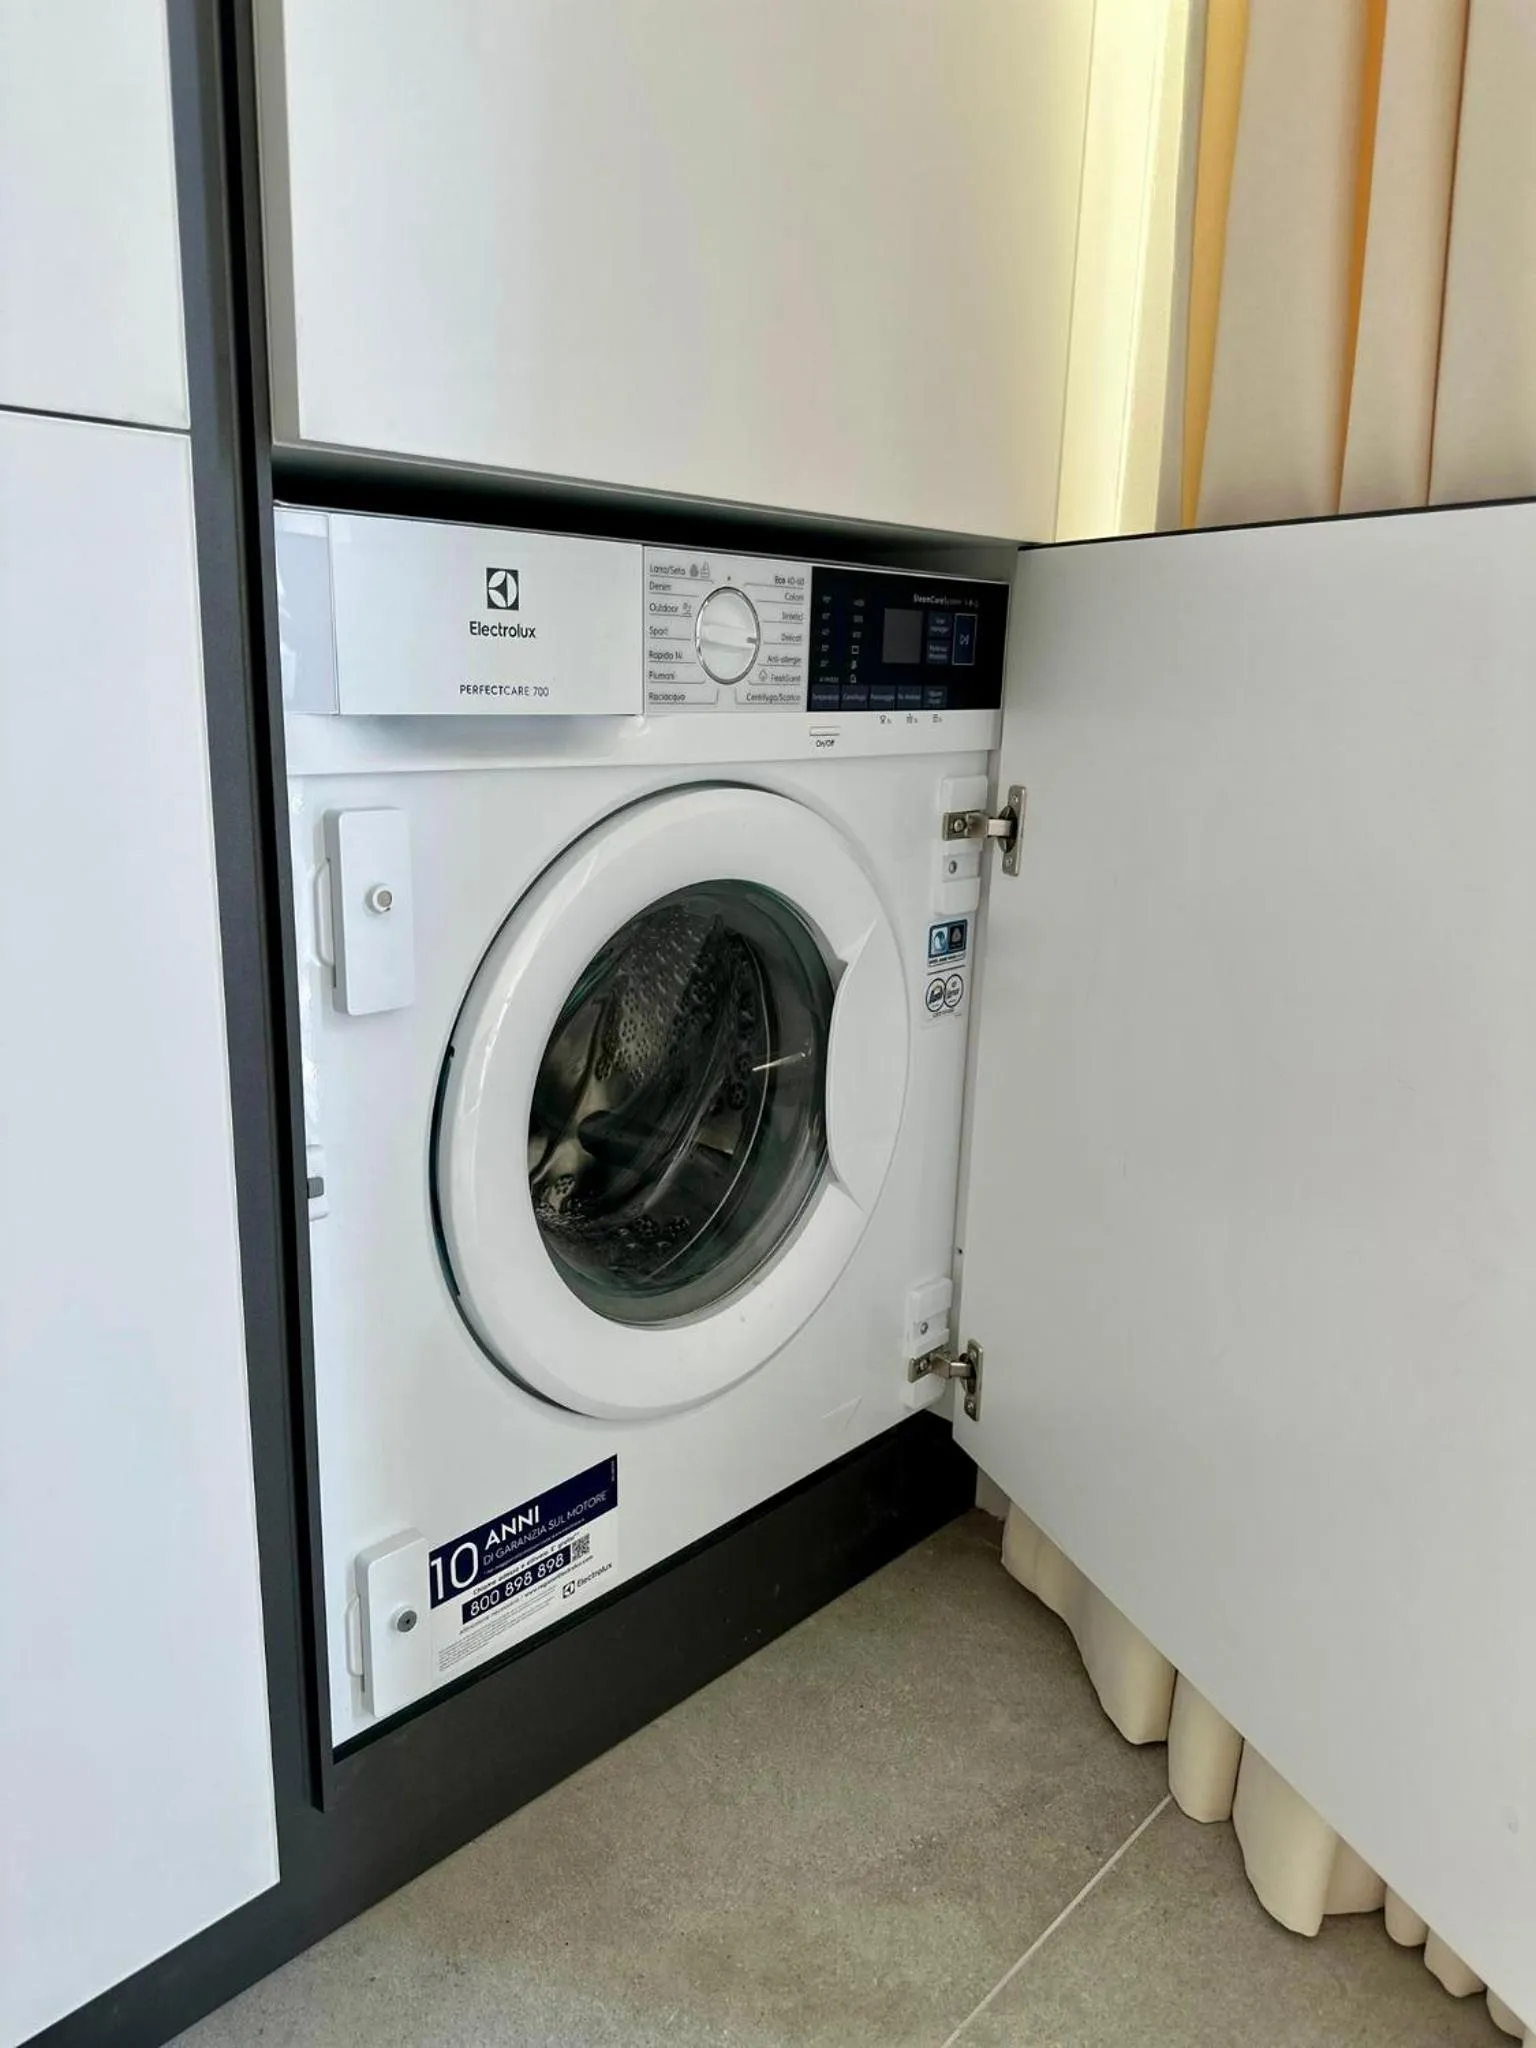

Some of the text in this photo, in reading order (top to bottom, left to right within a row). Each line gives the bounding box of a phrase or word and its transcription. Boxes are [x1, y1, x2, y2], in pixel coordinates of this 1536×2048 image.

[774, 575, 785, 585] Eco
[649, 602, 679, 613] Outdoor
[469, 620, 536, 639] Electrolux
[649, 626, 669, 637] Sport
[649, 650, 674, 661] Rapido
[459, 684, 550, 697] PERFECTCARE 700
[815, 740, 835, 748] On/Off
[484, 1504, 539, 1550] ANNI
[483, 1552, 494, 1566] DI
[495, 1525, 547, 1558] GARANZIA
[548, 1515, 566, 1530] SUL
[430, 1541, 479, 1600] 10
[577, 1562, 613, 1588] Electrolux
[470, 1553, 565, 1616] 800 898 898
